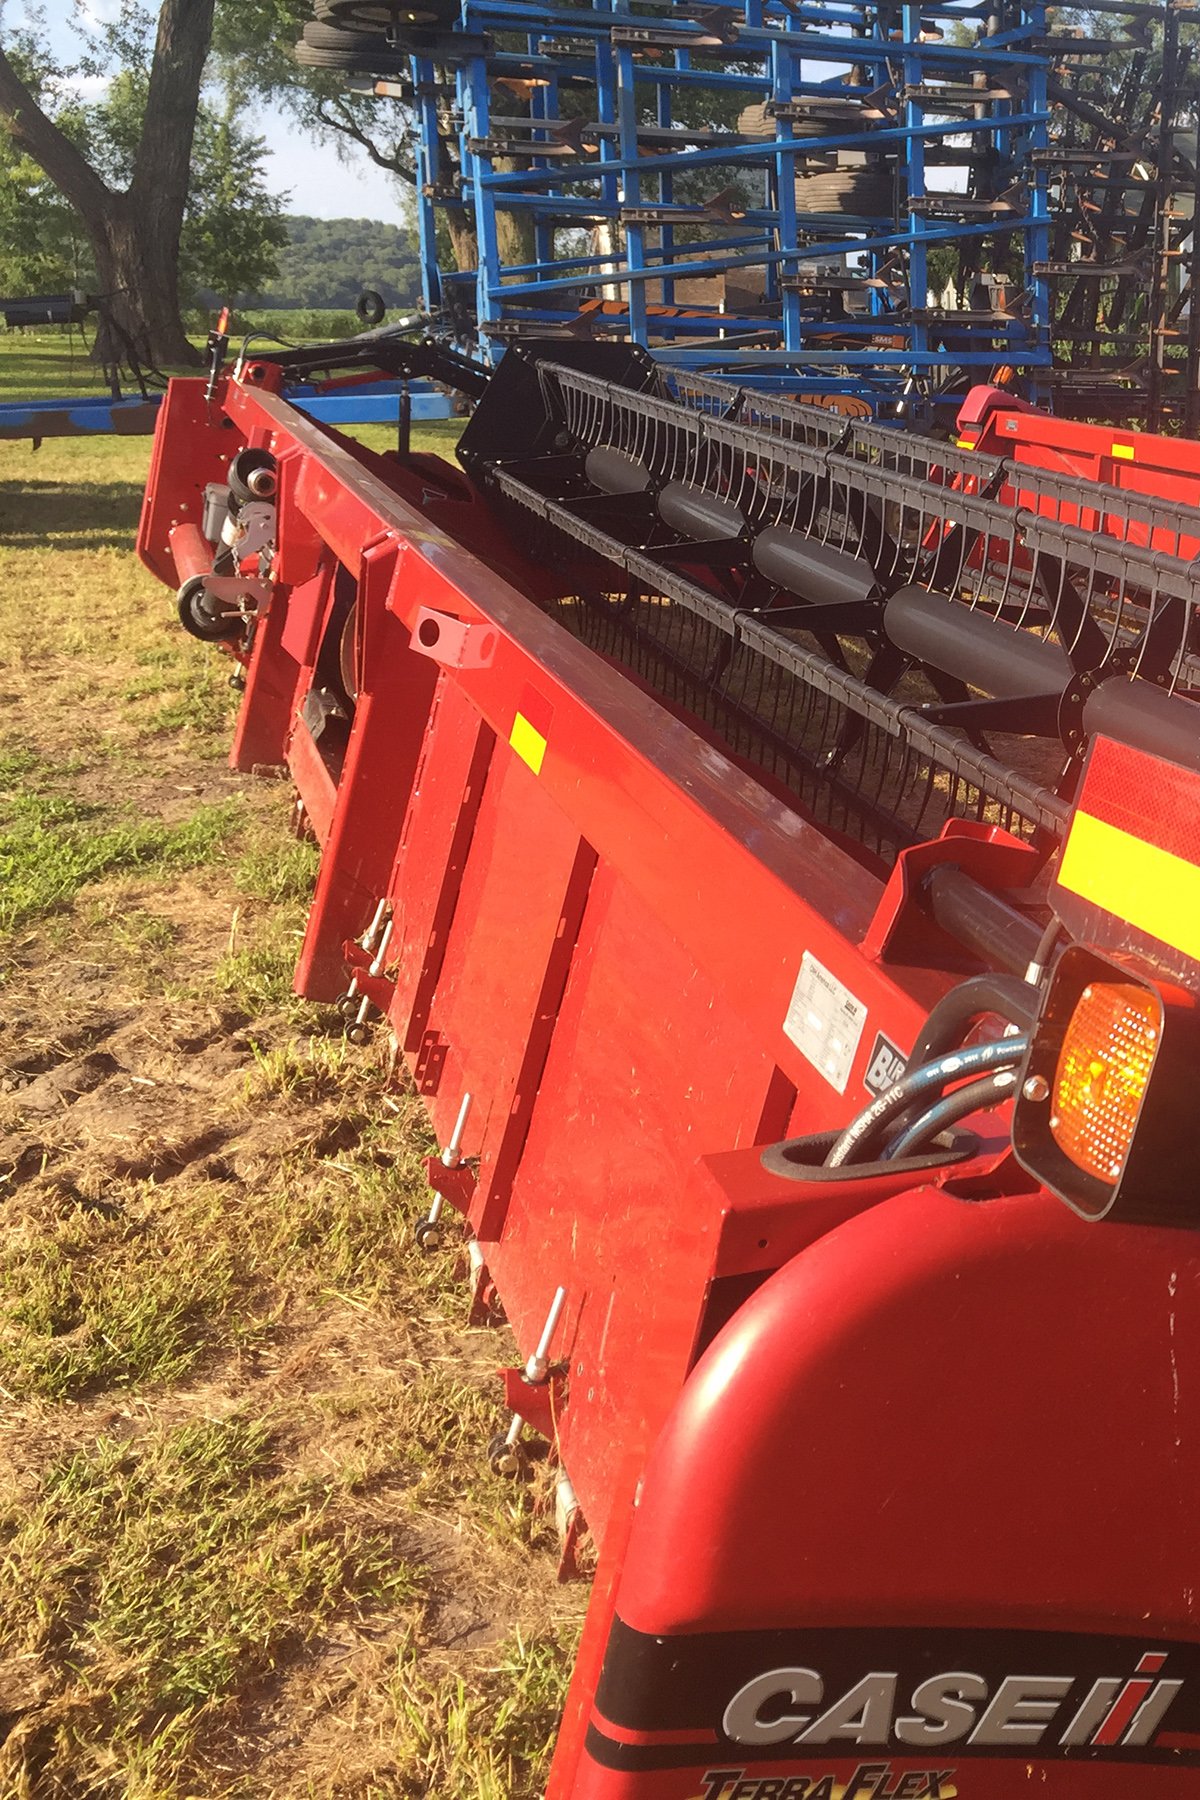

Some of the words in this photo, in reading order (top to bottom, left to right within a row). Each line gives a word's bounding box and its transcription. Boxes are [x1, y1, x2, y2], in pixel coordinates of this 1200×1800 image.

[849, 1111, 876, 1139] MSHA
[870, 1086, 904, 1117] 2G-11C
[722, 1666, 1075, 1746] CASE
[840, 1761, 956, 1800] FLEX
